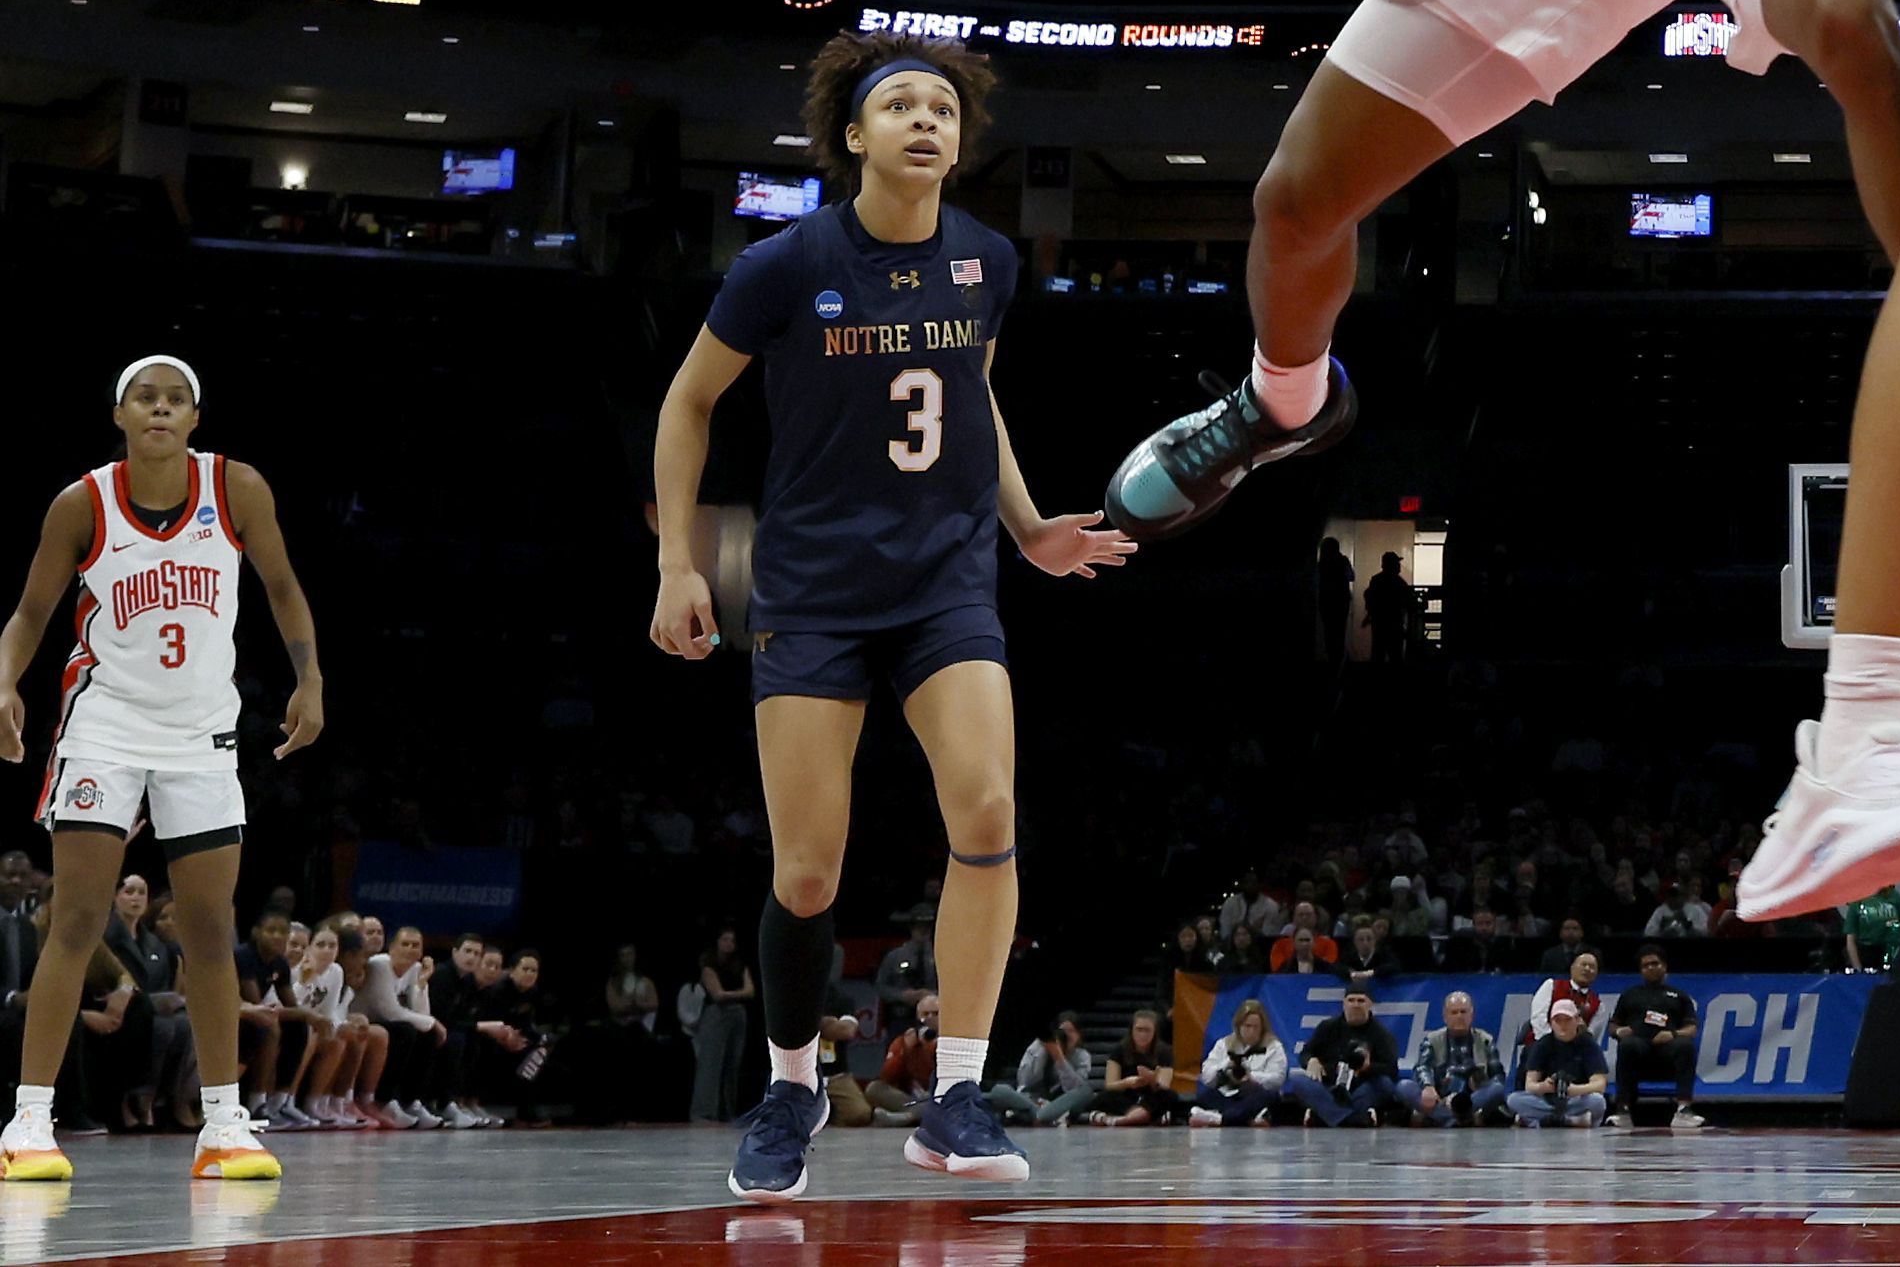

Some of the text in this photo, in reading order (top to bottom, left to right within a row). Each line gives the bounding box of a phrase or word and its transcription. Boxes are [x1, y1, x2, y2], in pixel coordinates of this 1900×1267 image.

[894, 11, 977, 40] FIRST
[1005, 20, 1116, 47] SECOND
[1123, 24, 1233, 47] ROUNDS
[824, 324, 911, 356] NOTRE
[888, 368, 943, 472] 3
[159, 623, 186, 669] 3
